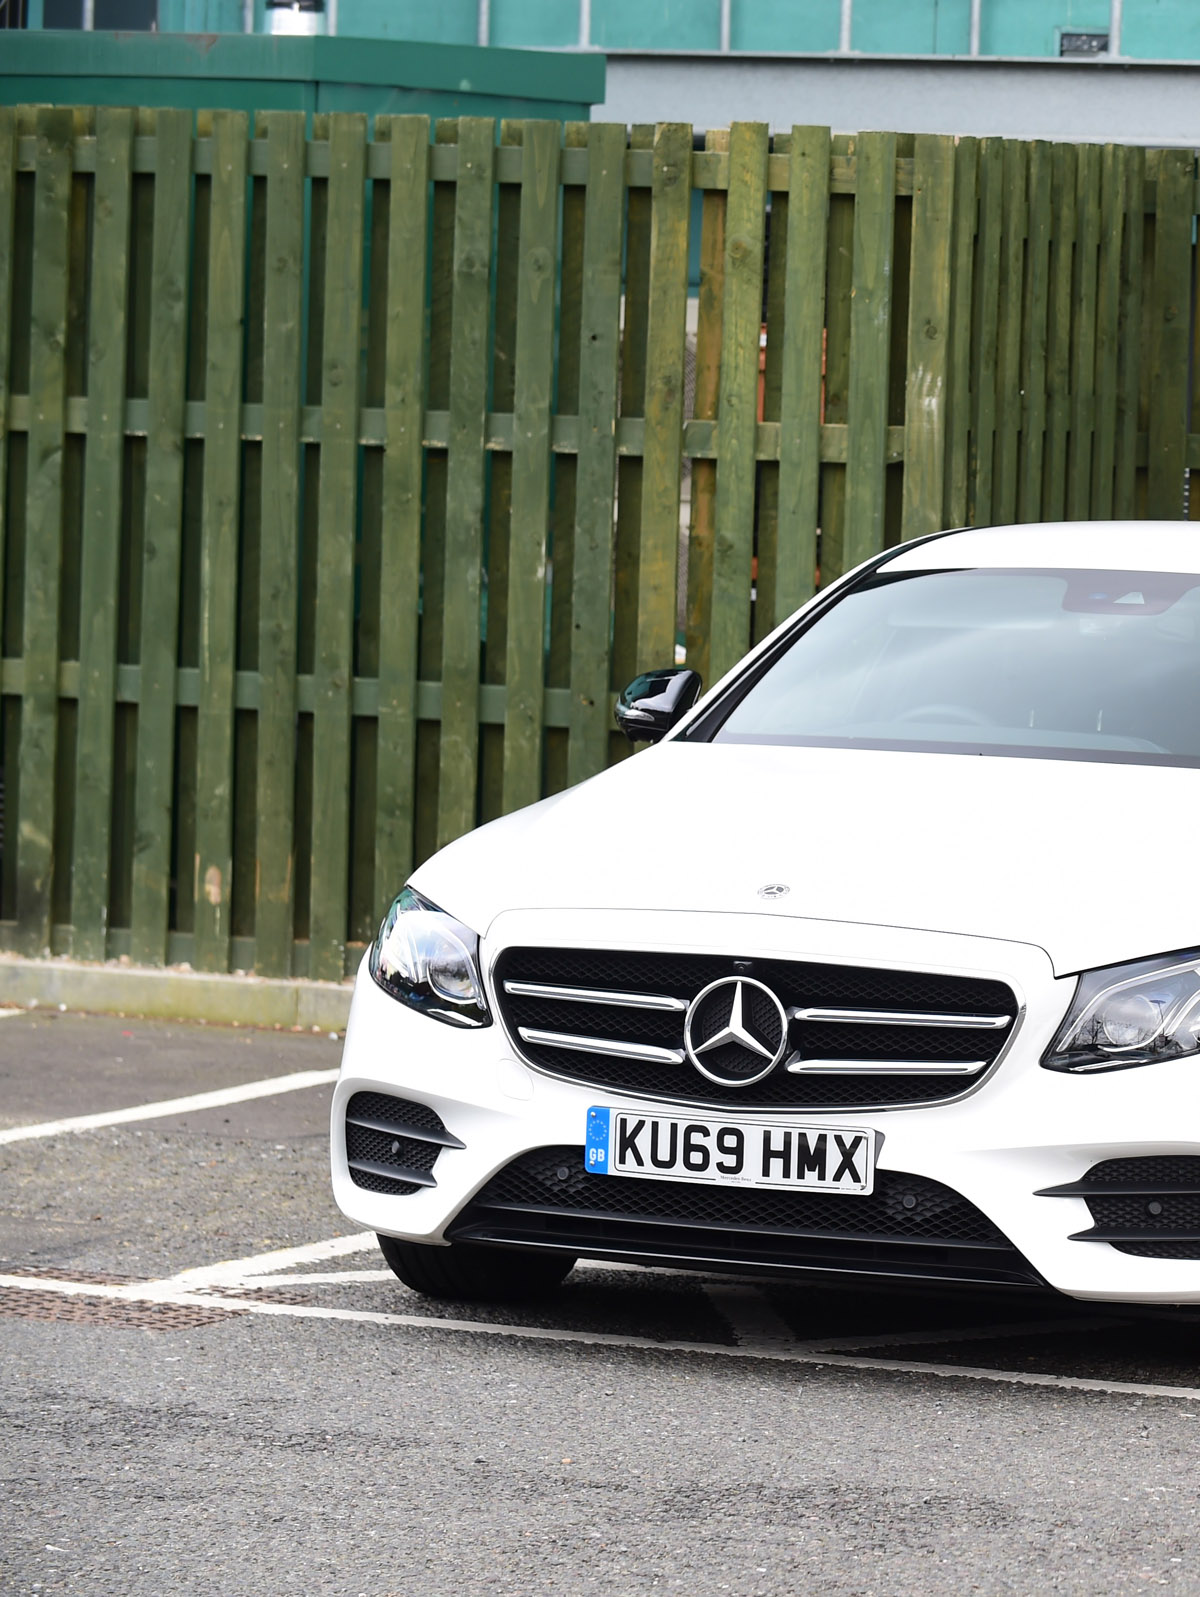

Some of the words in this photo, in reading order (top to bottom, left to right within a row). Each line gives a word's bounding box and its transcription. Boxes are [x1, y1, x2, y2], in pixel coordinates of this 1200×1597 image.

[589, 1147, 606, 1163] GB
[617, 1117, 745, 1175] KU69
[761, 1129, 863, 1184] HMX
